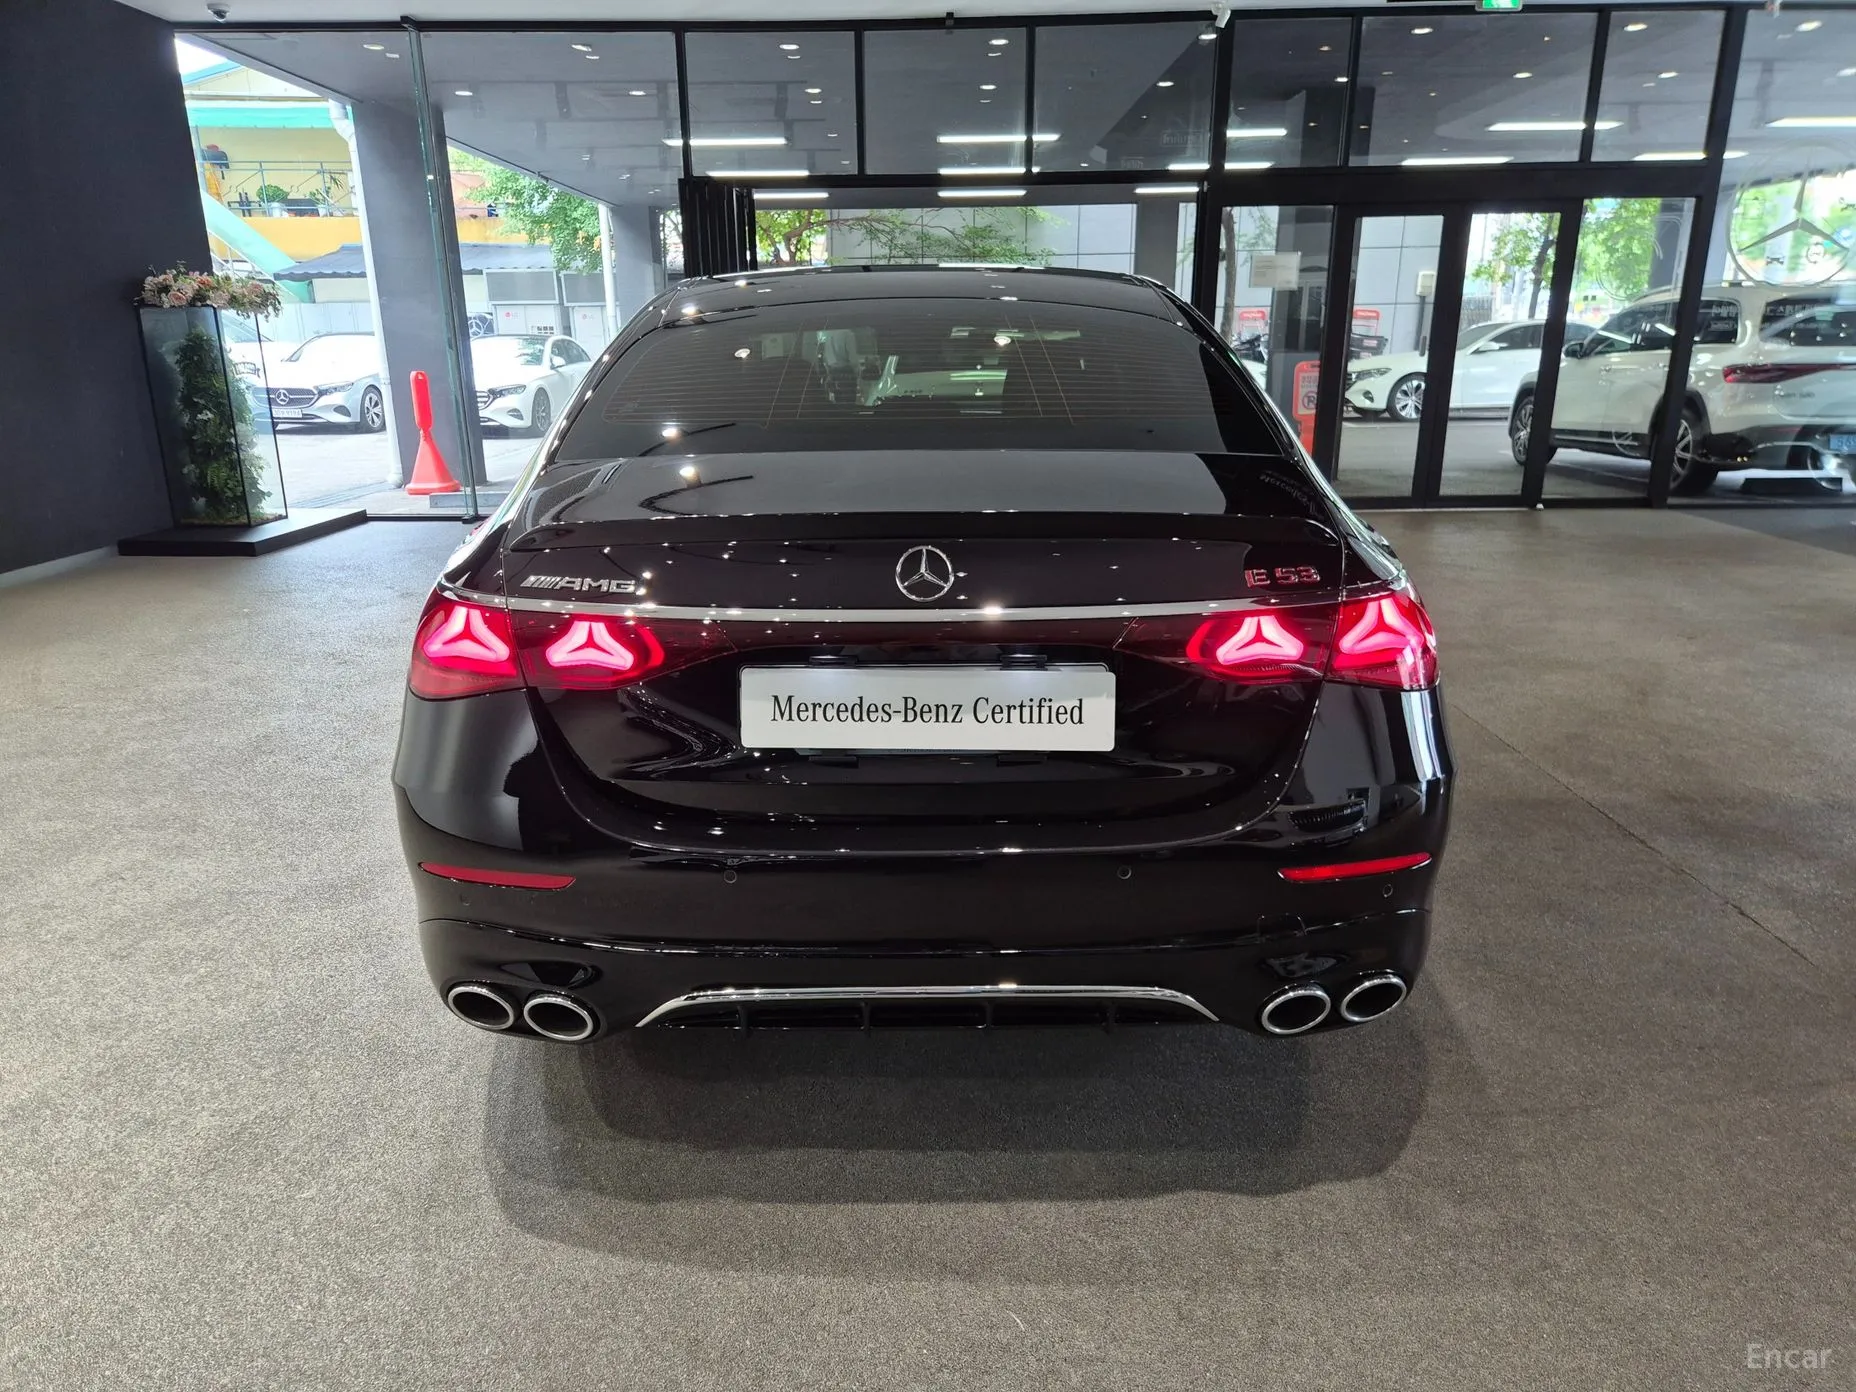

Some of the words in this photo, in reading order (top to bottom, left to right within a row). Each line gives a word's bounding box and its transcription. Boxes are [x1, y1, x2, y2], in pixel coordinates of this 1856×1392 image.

[553, 577, 636, 594] AMG
[1245, 568, 1271, 587] E
[1275, 566, 1321, 585] 53
[771, 695, 964, 725] Mercedes-Benz
[973, 696, 1085, 726] Certified
